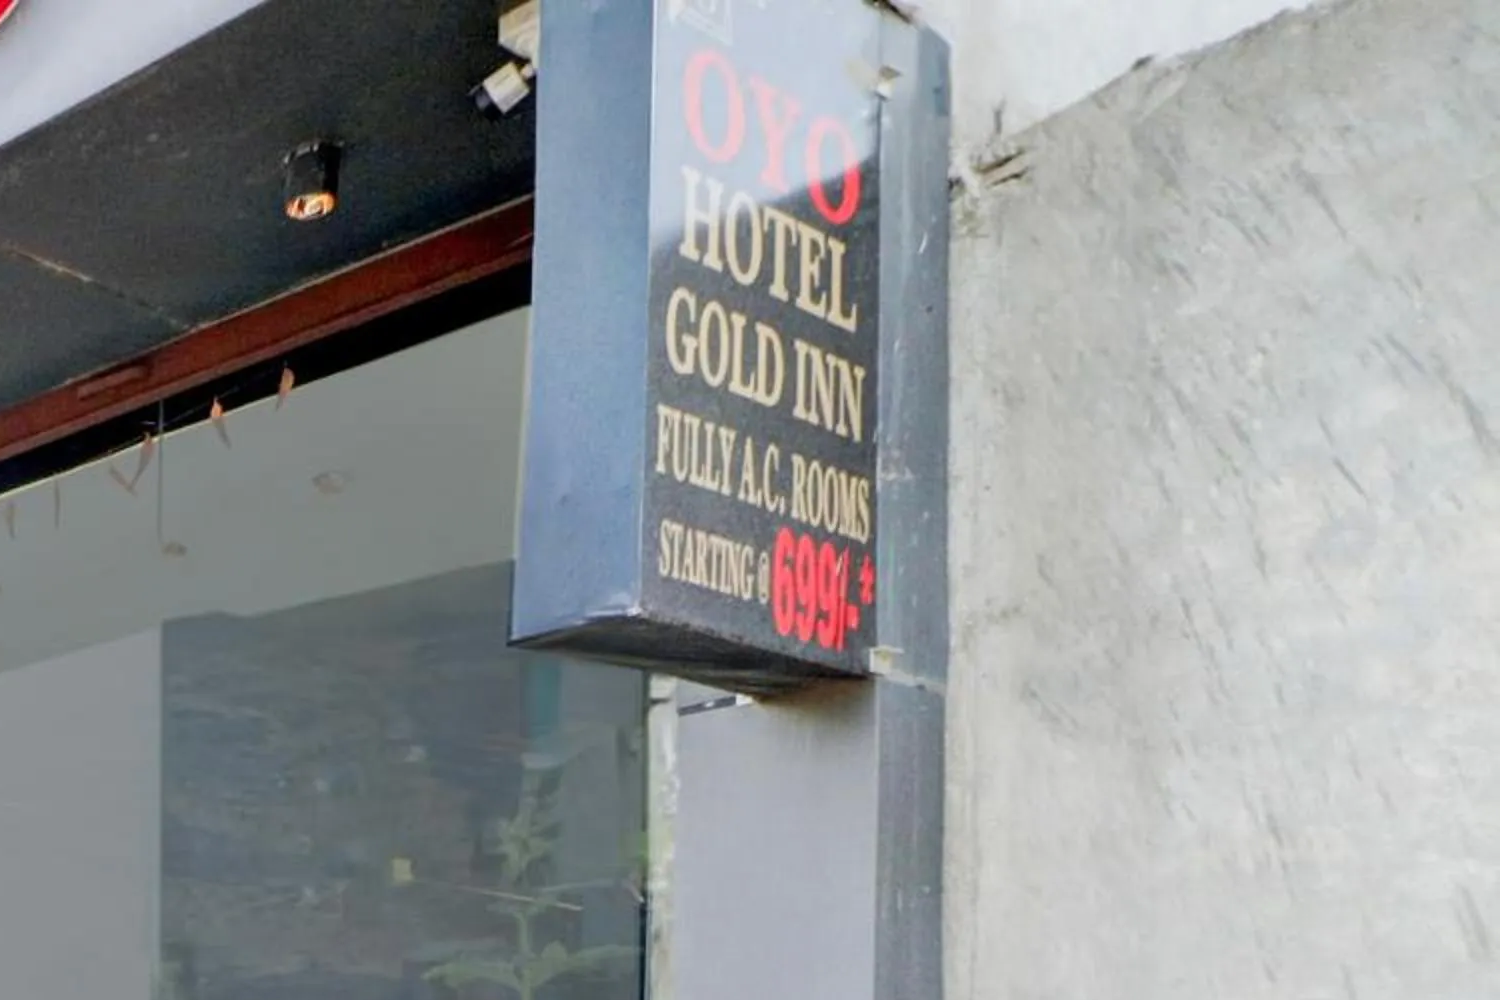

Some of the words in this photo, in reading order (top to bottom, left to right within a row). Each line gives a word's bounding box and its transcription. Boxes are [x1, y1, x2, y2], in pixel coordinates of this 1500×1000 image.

[682, 47, 862, 225] OYO
[679, 165, 857, 333] HOTEL
[666, 286, 785, 407] GOLD
[793, 338, 866, 442] INN
[656, 403, 737, 496] FULLY
[791, 453, 871, 544] ROOMS
[659, 518, 754, 600] STARTING
